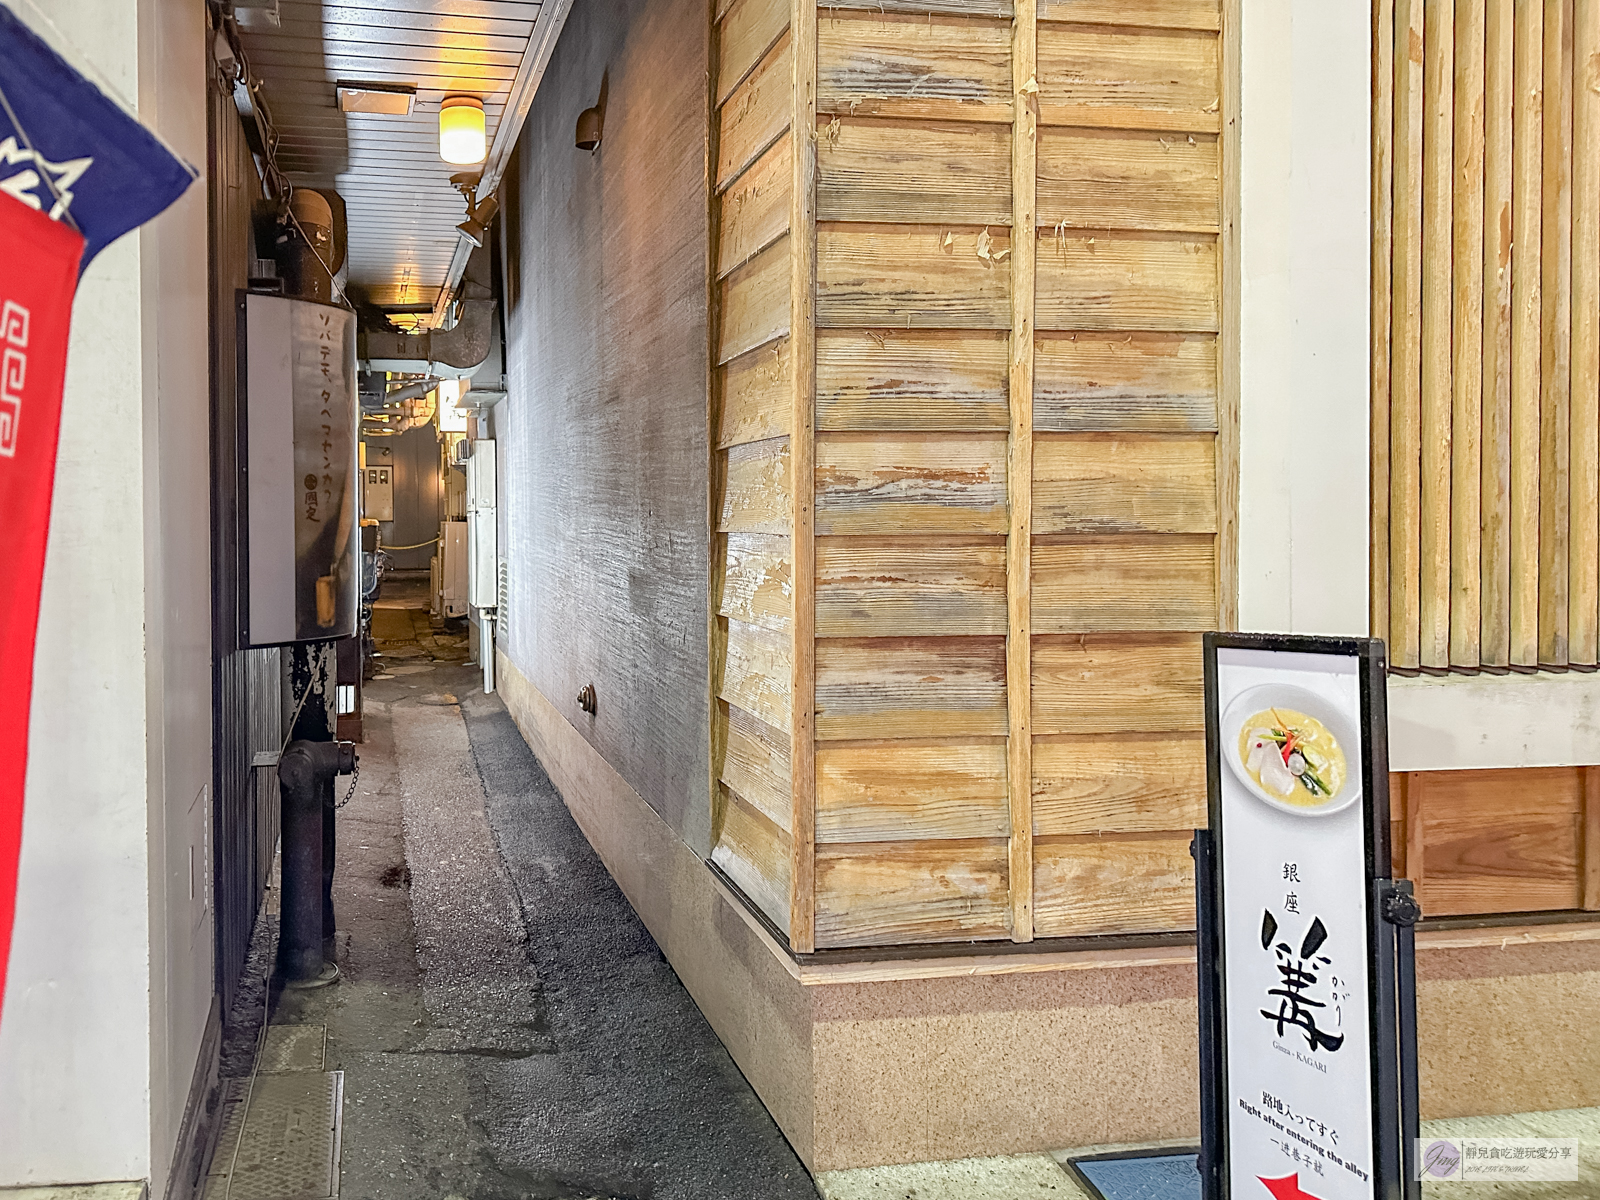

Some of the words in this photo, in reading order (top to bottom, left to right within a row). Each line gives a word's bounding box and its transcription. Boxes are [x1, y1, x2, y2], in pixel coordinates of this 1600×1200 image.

[1282, 862, 1301, 915] 銀座
[1260, 907, 1344, 1052] 篝
[1332, 976, 1350, 1027] かがり
[1272, 1040, 1291, 1056] Ginza
[1296, 1050, 1328, 1074] KAGARI
[1239, 1098, 1262, 1119] Right
[1263, 1114, 1285, 1132] after
[1286, 1128, 1325, 1157] entering
[1326, 1150, 1343, 1166] the
[1344, 1161, 1369, 1182] alley
[1262, 1090, 1339, 1146] 路地入ってすぐ
